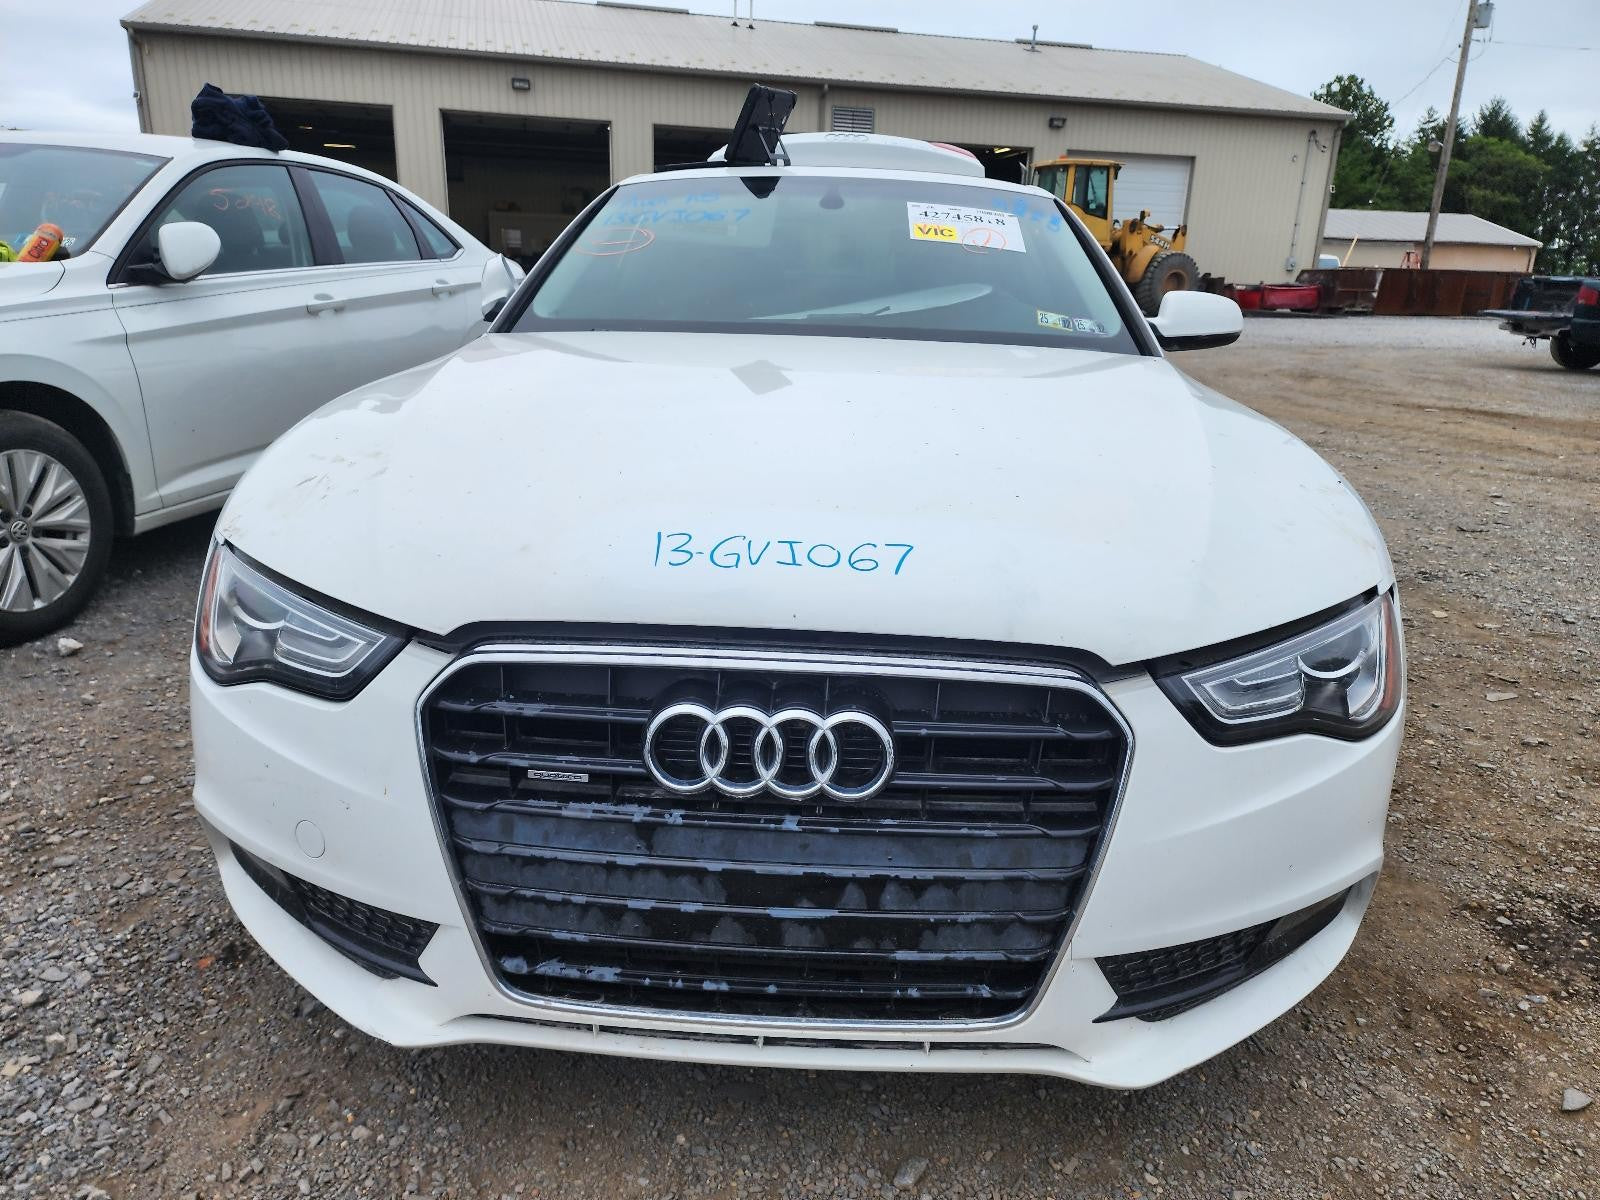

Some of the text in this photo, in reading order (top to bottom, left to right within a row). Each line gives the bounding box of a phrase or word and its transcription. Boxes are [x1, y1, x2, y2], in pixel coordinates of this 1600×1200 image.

[917, 226, 954, 238] VIC
[1149, 234, 1171, 251] 544H
[1039, 312, 1049, 324] 25
